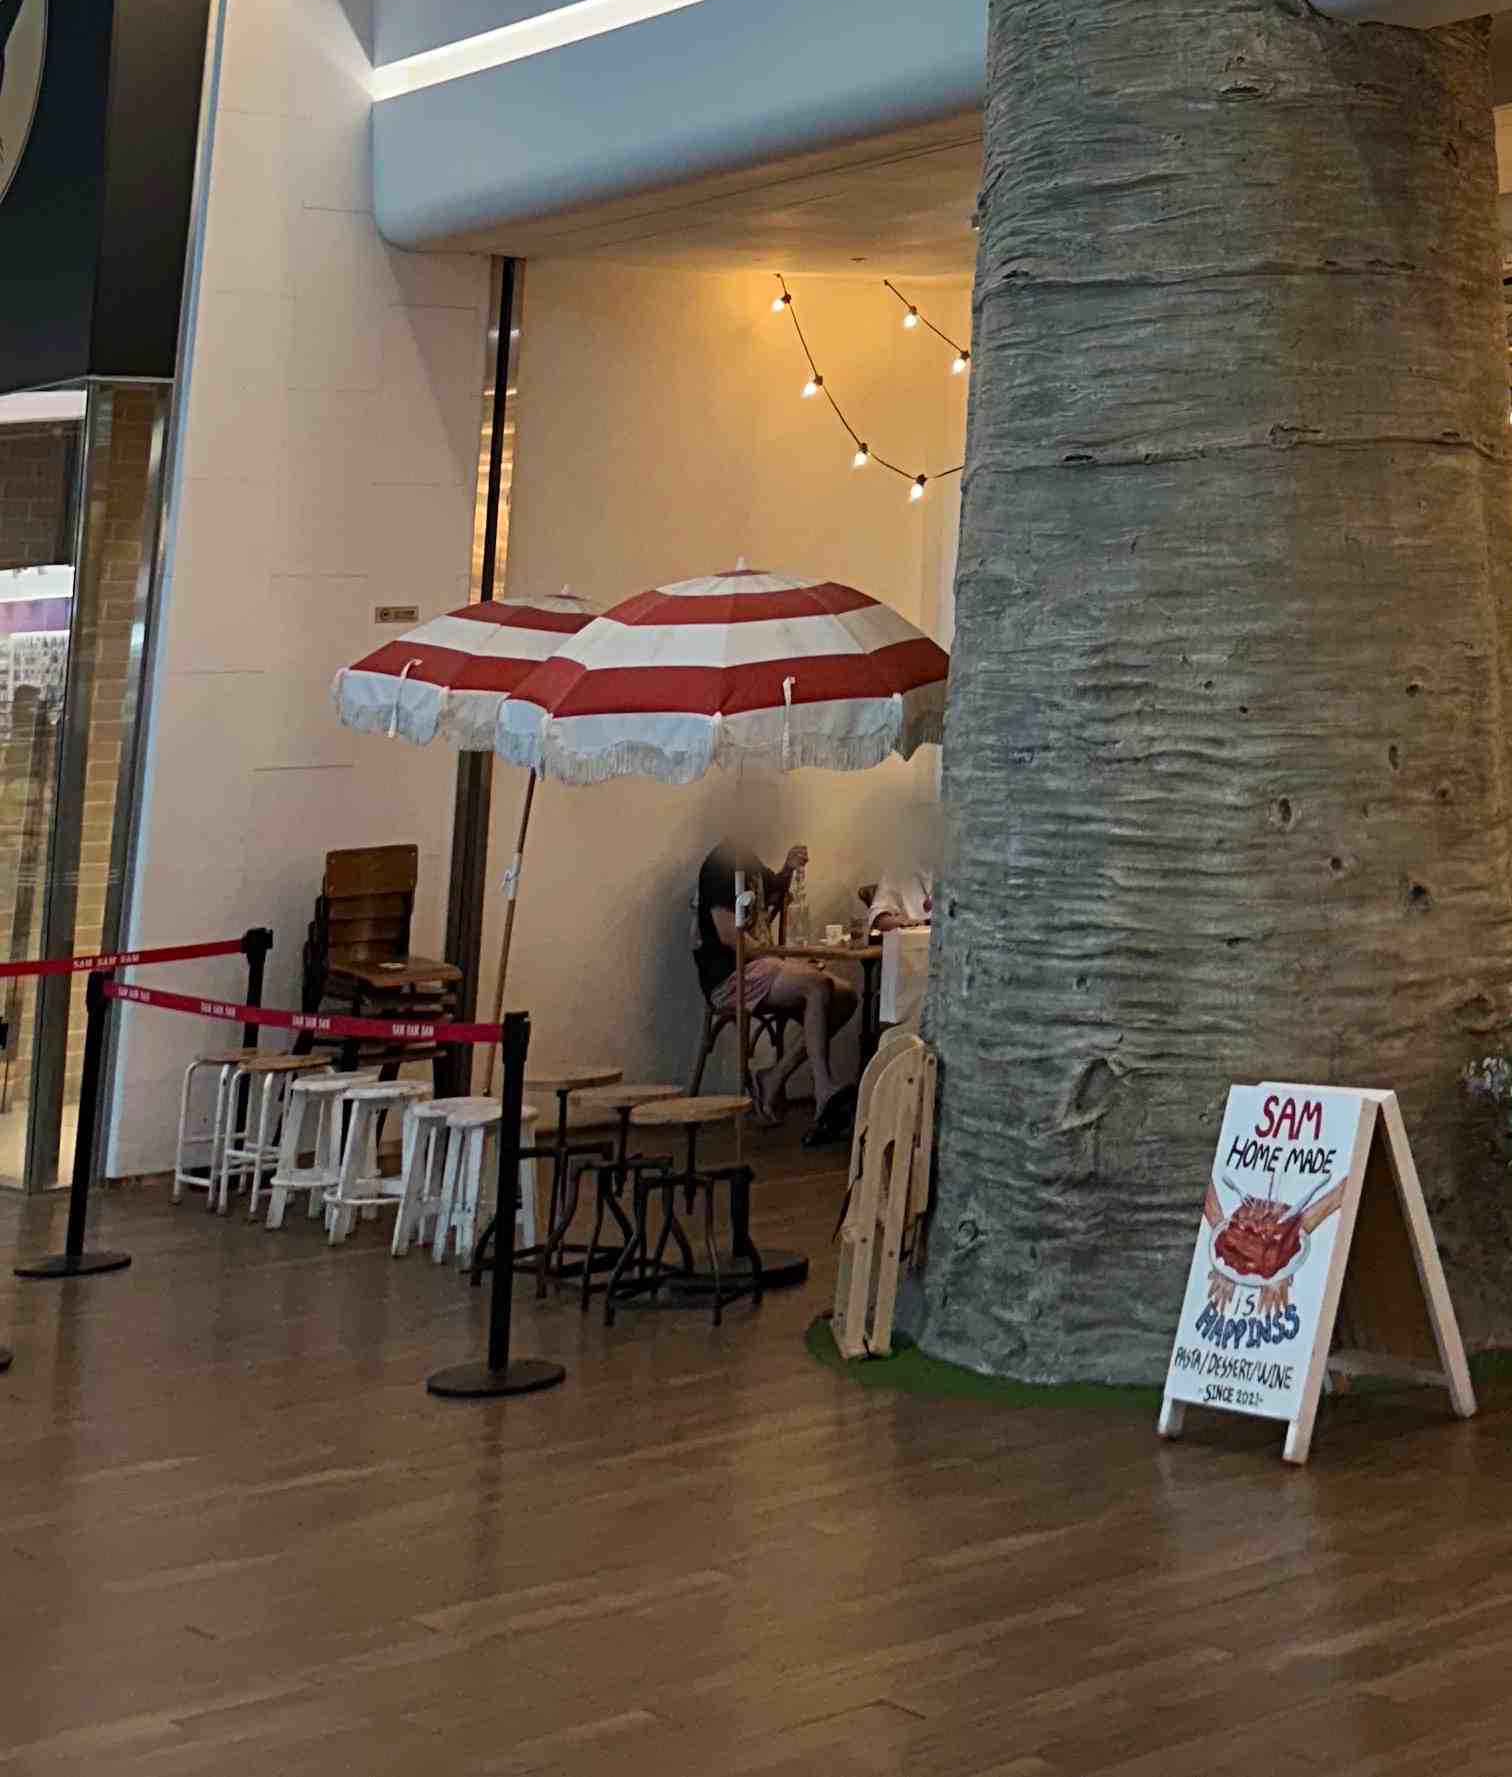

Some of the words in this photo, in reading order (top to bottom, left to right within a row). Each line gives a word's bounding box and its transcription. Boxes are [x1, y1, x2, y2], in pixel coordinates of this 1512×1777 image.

[1255, 1096, 1322, 1140] SAM
[1226, 1136, 1283, 1173] HOME
[1284, 1146, 1337, 1174] MADE
